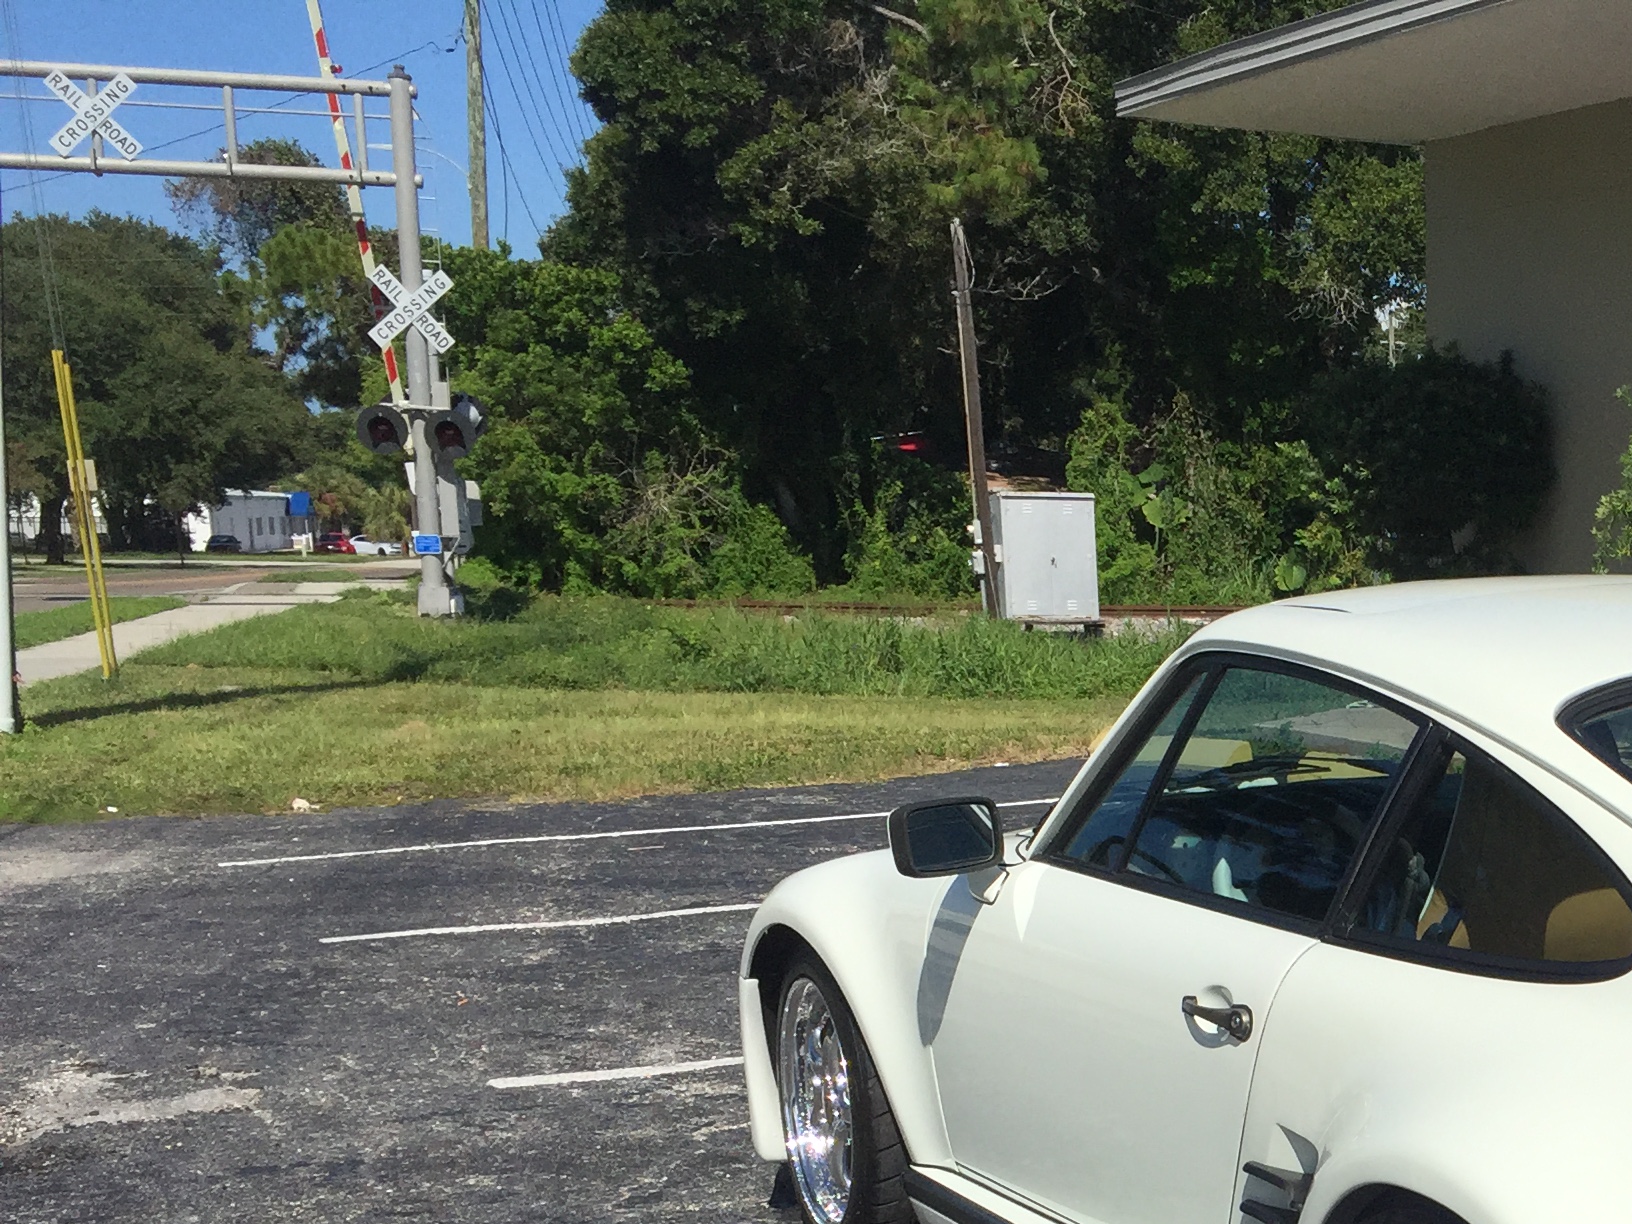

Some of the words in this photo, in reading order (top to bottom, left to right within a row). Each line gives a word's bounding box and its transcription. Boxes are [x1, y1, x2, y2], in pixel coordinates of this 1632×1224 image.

[48, 74, 83, 109] RAIL
[58, 80, 129, 148] CROSSING
[99, 120, 138, 155] ROAD
[373, 269, 402, 303] RAIL
[377, 278, 447, 340] CROSSING
[416, 314, 449, 348] ROAD
